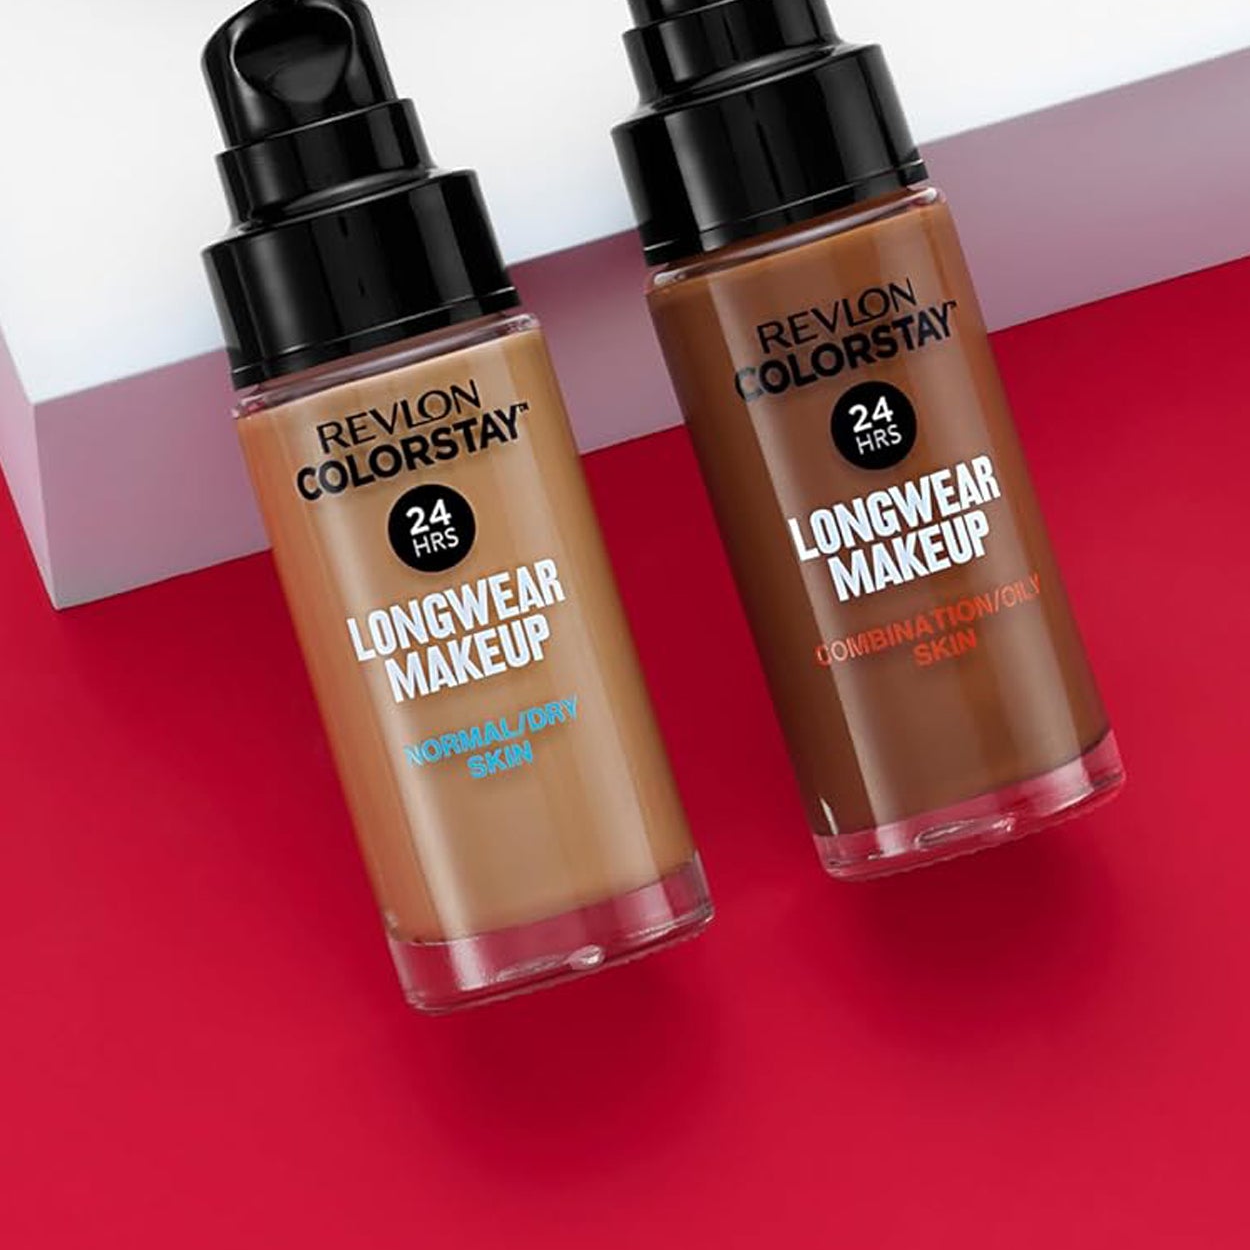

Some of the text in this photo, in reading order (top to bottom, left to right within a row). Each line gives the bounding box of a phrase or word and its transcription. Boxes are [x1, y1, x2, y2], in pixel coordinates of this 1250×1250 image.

[757, 278, 917, 354] REVLON
[316, 379, 481, 455] REVLON
[848, 396, 894, 433] 24
[855, 424, 902, 456] HRS
[406, 498, 452, 536] 24
[412, 526, 460, 558] HRS
[787, 454, 1002, 563] LONGWEAR
[827, 509, 991, 603] MAKEUP
[346, 557, 567, 663] LONGWEAR
[815, 573, 1041, 667] COMBINATION/OILY
[384, 613, 551, 703] MAKEUP
[912, 628, 977, 667] SKIN
[403, 693, 578, 766] NORMAL/DRY
[466, 740, 533, 779] SKIN
